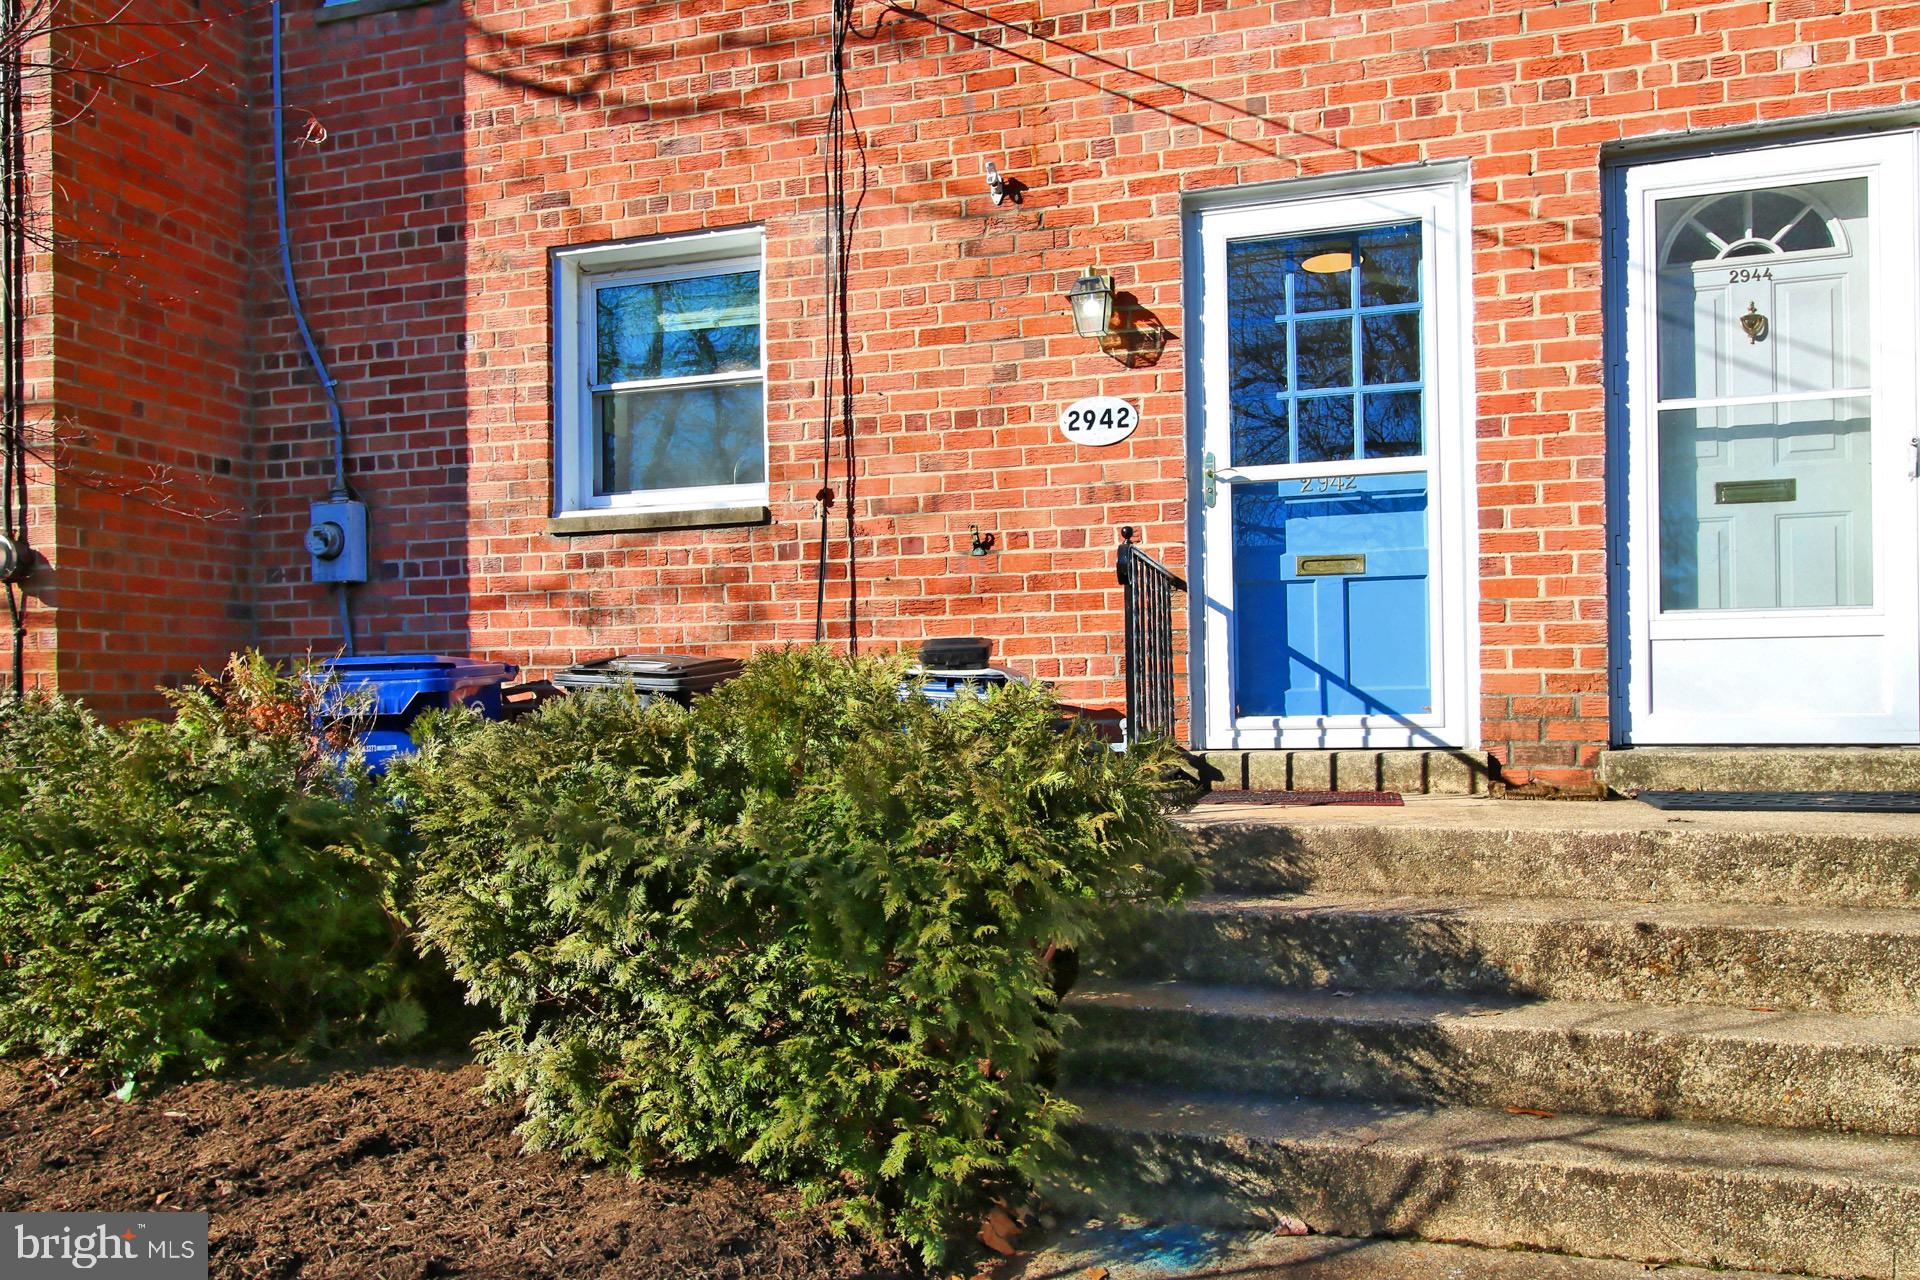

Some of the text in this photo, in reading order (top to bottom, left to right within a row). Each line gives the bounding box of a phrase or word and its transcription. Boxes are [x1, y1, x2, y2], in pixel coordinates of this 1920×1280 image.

[1729, 267, 1773, 283] 2944
[1068, 407, 1129, 431] 2942
[1301, 476, 1357, 493] 2942
